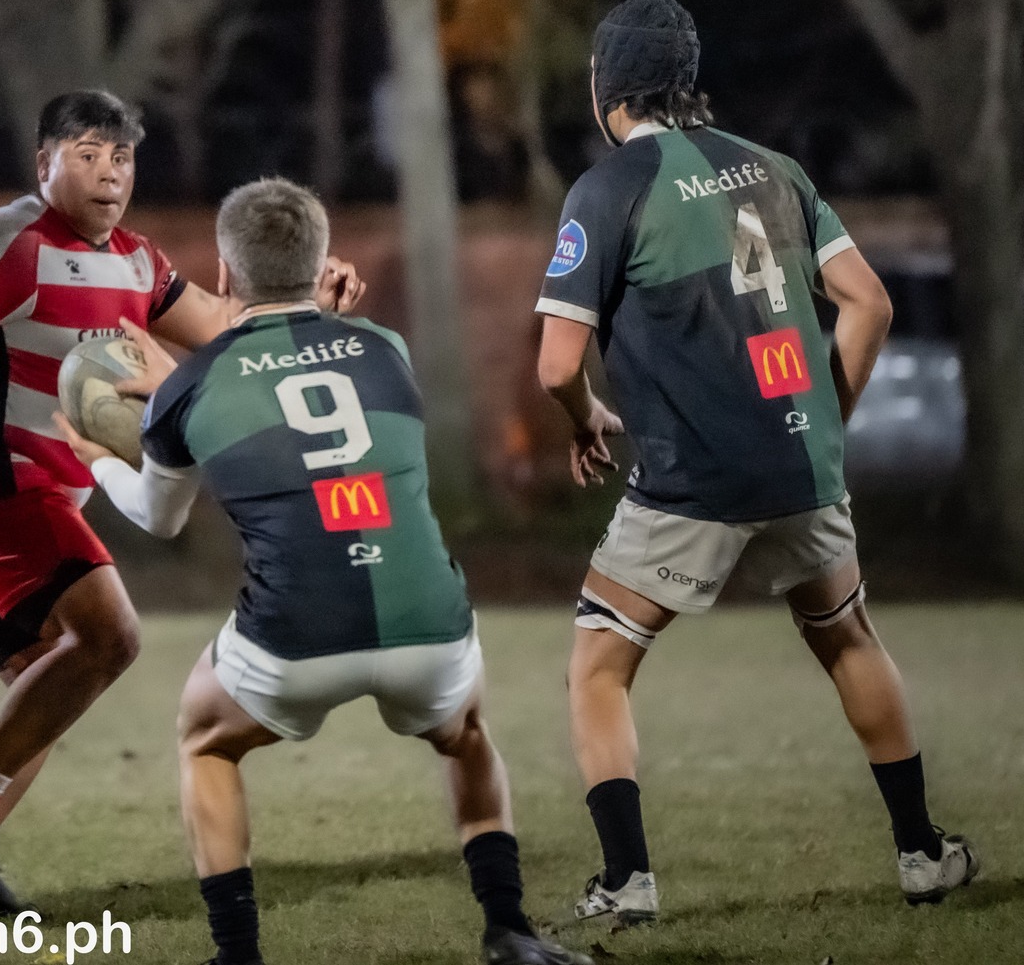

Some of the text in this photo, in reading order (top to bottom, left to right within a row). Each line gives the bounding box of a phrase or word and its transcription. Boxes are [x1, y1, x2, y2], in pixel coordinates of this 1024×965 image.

[673, 162, 769, 202] Medifé
[558, 239, 578, 258] POL
[730, 201, 787, 314] 4
[238, 336, 365, 377] Medifé
[275, 370, 373, 470] 9
